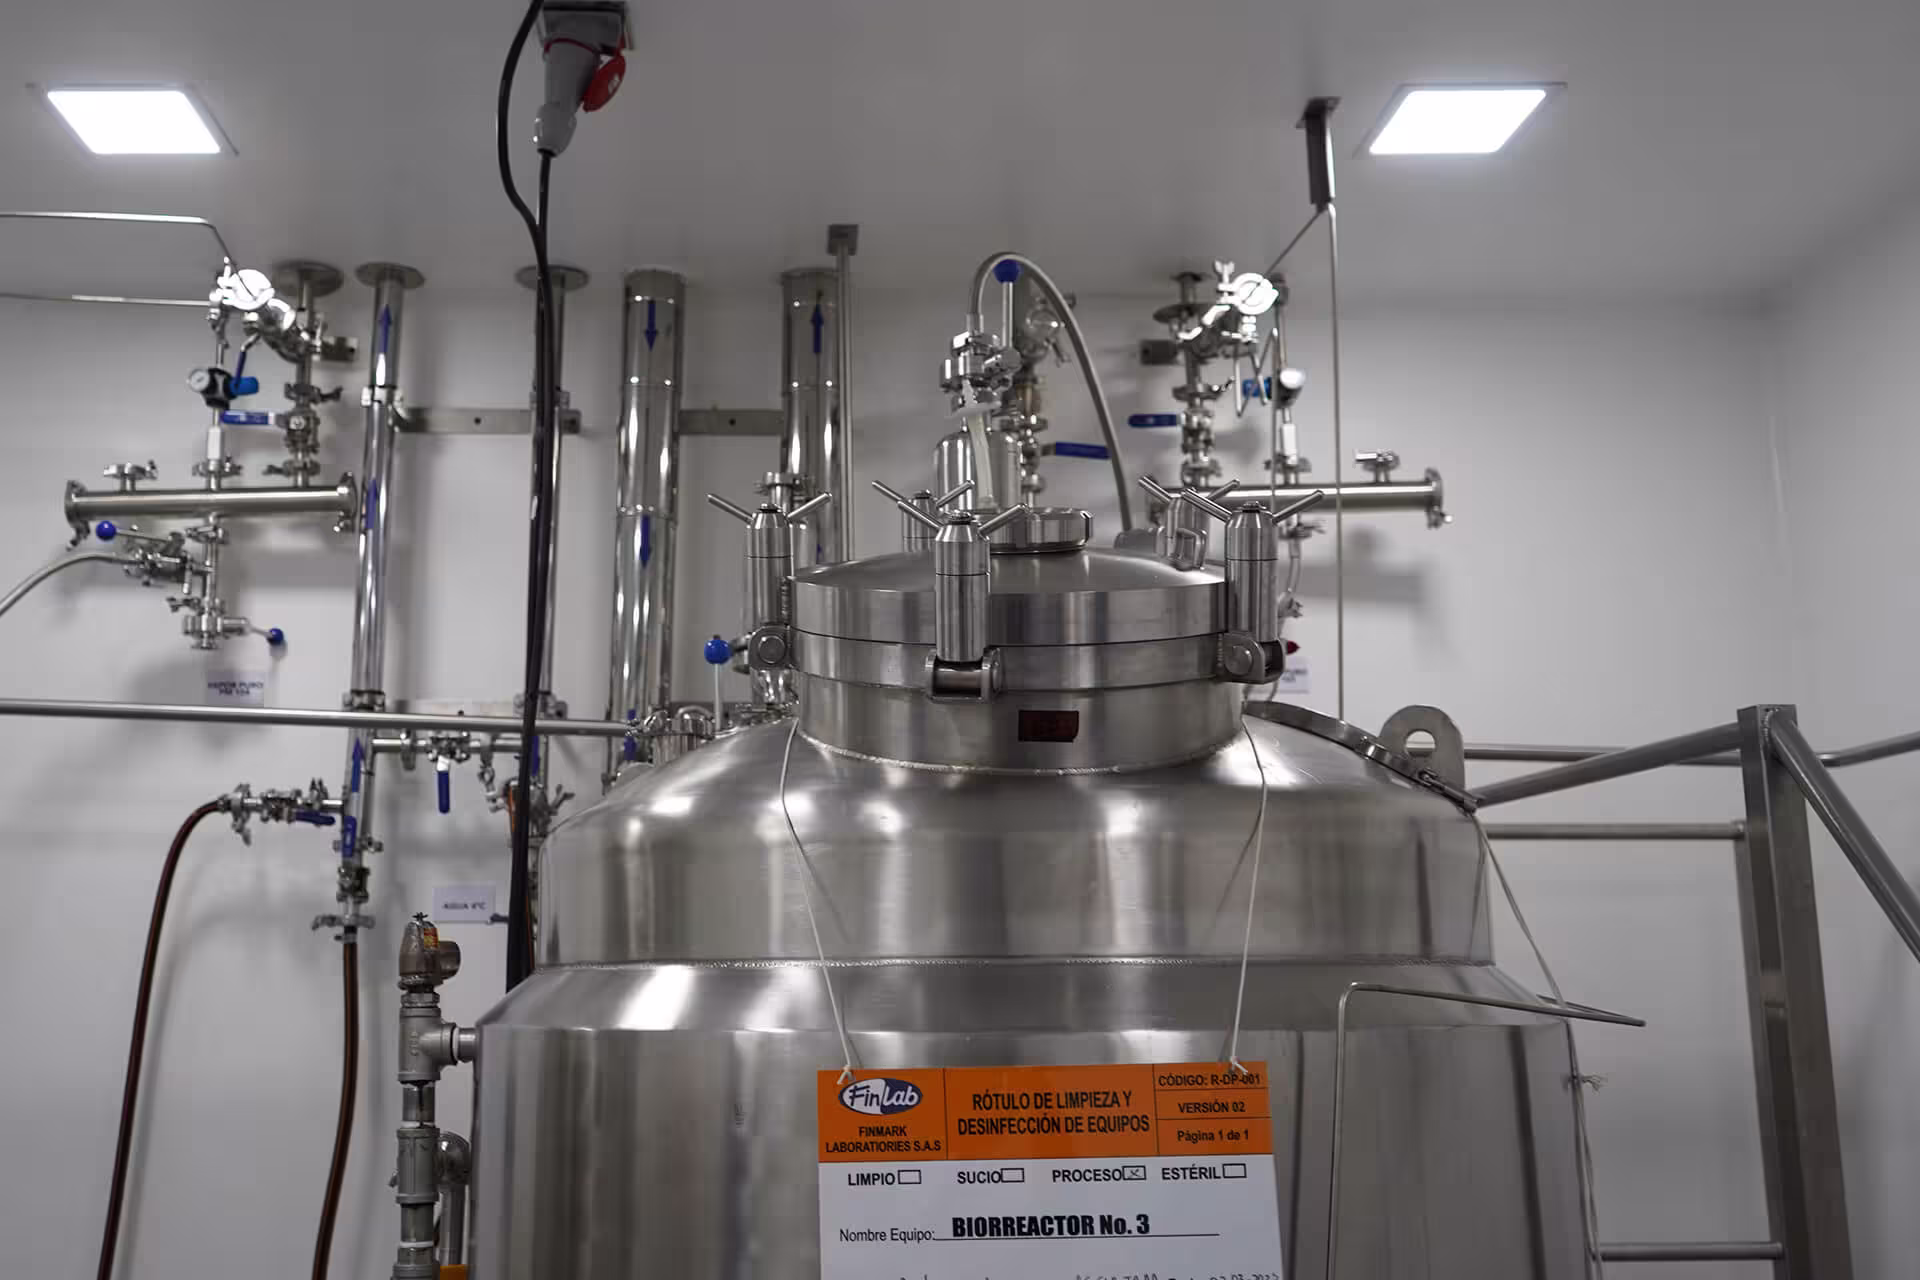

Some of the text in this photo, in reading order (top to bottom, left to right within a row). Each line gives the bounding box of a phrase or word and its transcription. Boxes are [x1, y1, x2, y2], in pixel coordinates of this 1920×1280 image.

[1158, 1072, 1260, 1087] CÓDIGO: R-DP-001
[847, 1084, 920, 1107] FinLab
[972, 1089, 1132, 1110] RÓTULO DE LIMPIEZA Y
[1178, 1099, 1246, 1113] VERSIÓN 02
[858, 1125, 907, 1137] FINMARK
[958, 1113, 1150, 1135] DESINFECCIÓN DE EQUIPOS
[1177, 1129, 1249, 1144] Página 1 de 1
[825, 1140, 942, 1153] LABORATIORIES S.A.S
[848, 1164, 1221, 1186] LIMPIO SUCIO PROCESO ESTÉRIL
[839, 1213, 1149, 1244] Nombre Equipo: BIORREACTOR No. 3
